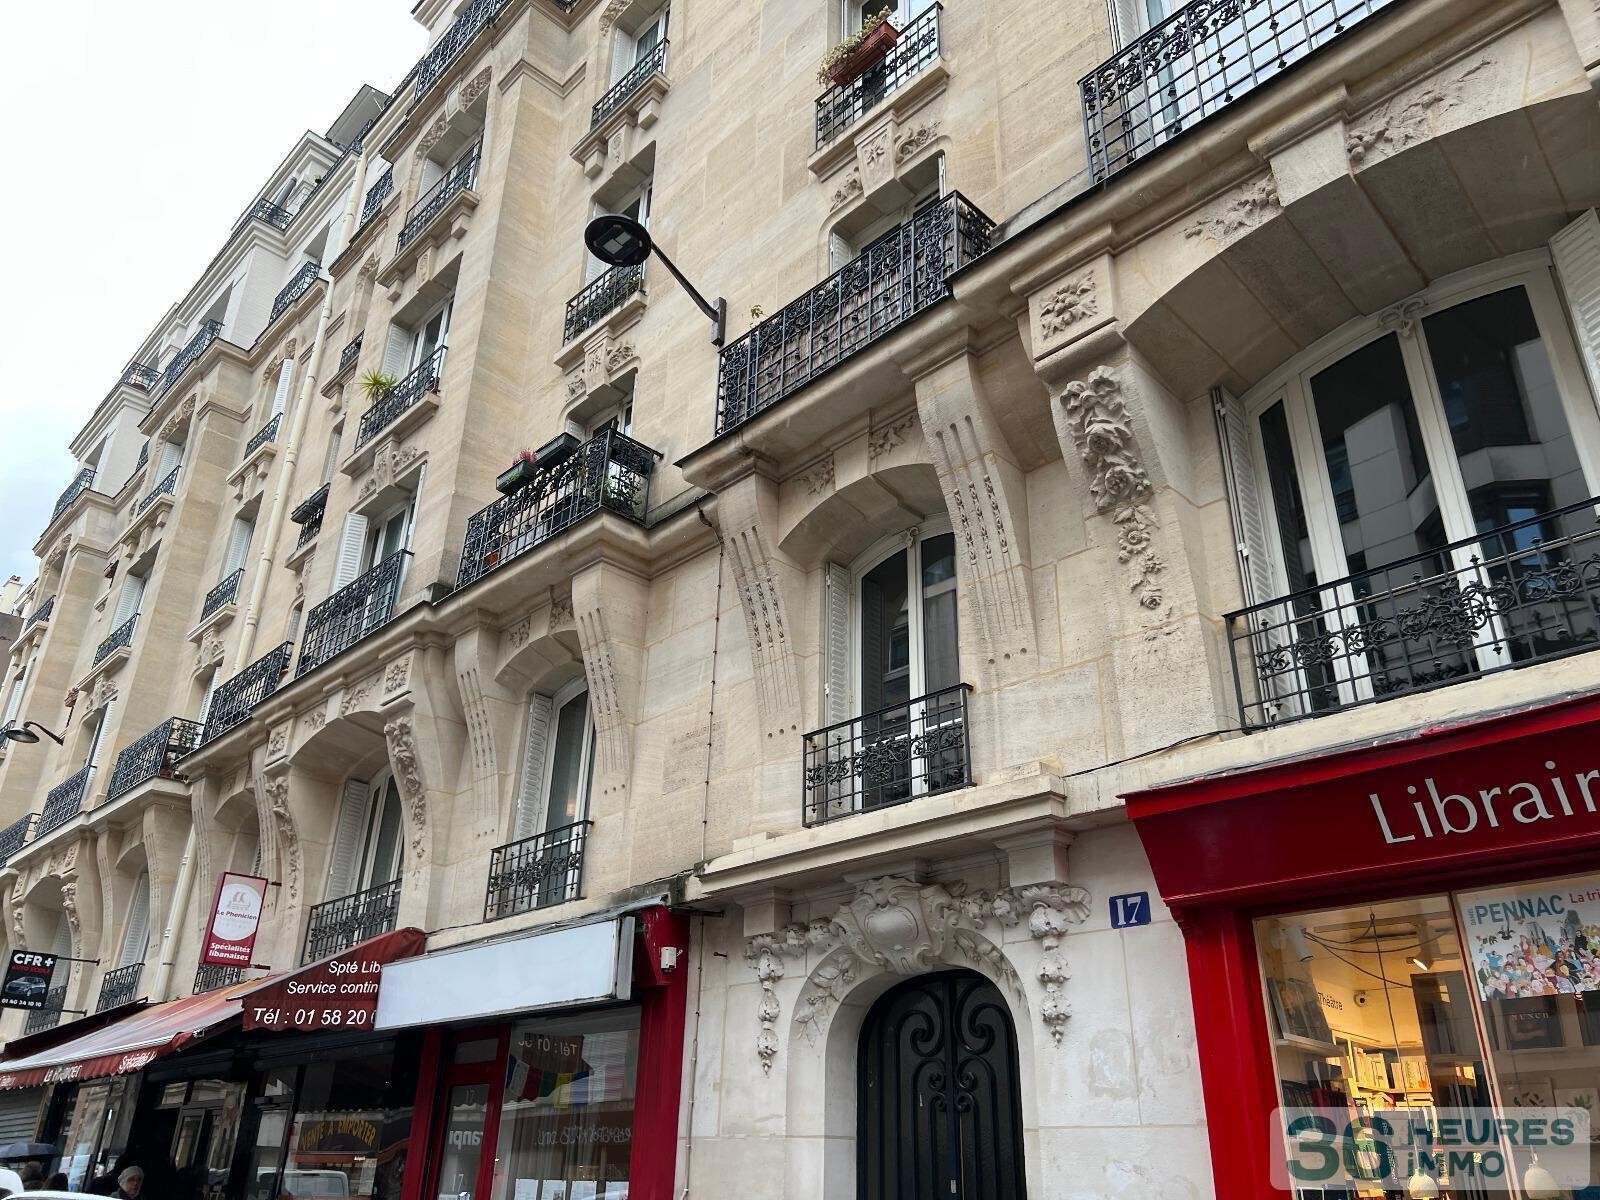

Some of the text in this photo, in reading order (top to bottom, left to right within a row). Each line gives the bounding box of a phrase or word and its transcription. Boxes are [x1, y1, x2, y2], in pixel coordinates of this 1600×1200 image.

[1368, 760, 1600, 844] Librair
[1569, 892, 1585, 904] La
[1115, 895, 1142, 926] 17
[1475, 894, 1566, 925] PENNAC
[13, 953, 43, 967] CFR
[208, 950, 249, 961] libanaises
[328, 960, 381, 976] Spté Lib
[287, 981, 379, 995] Service contin
[253, 1007, 281, 1025] Tél
[294, 1008, 315, 1025] 01
[320, 1009, 342, 1025] 58
[346, 1009, 367, 1025] 20
